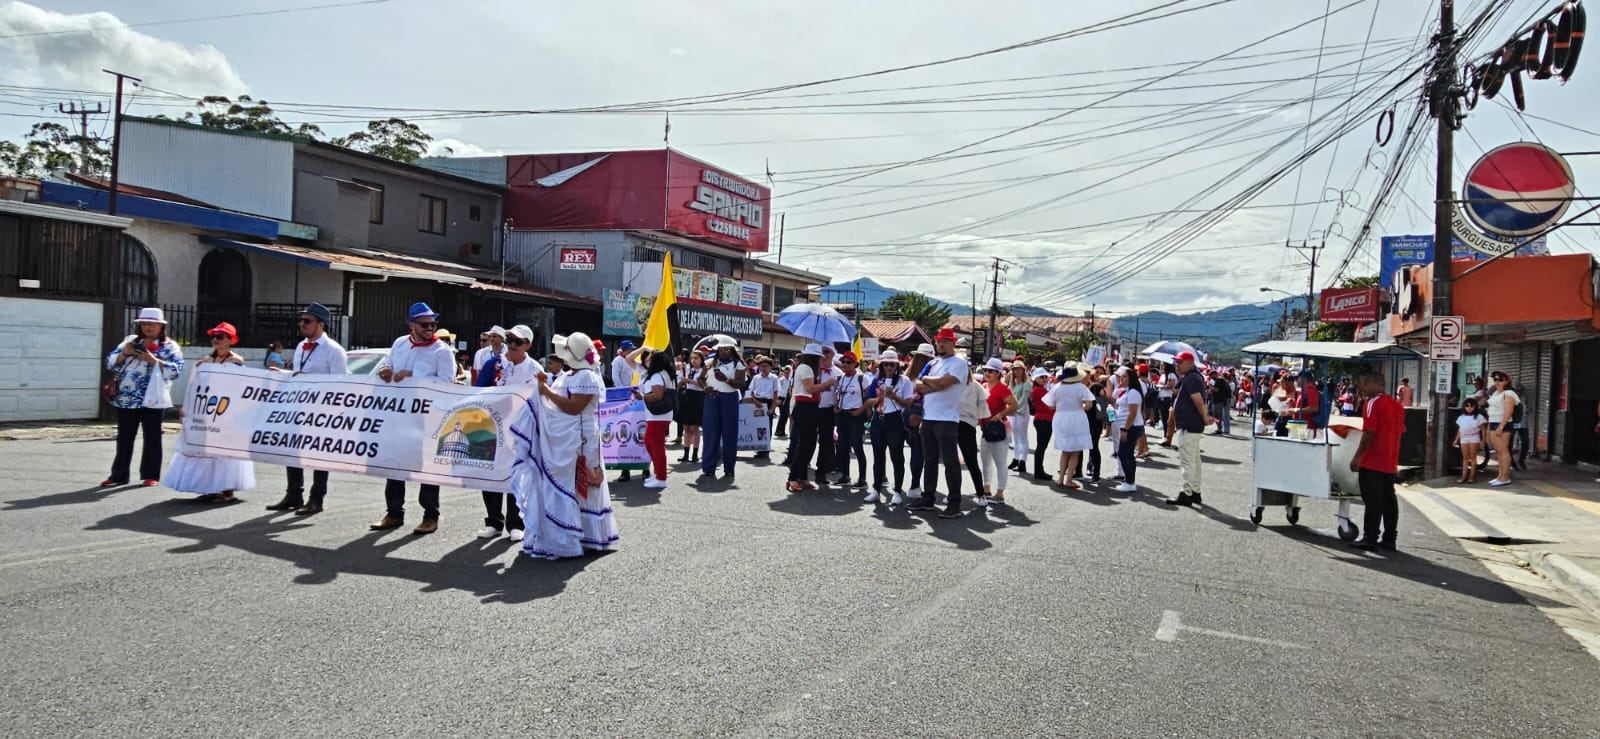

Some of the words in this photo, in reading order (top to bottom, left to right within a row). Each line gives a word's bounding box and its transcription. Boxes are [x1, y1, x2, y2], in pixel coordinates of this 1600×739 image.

[704, 170, 760, 200] DISTRIBUIDORA
[1452, 219, 1510, 254] BURGUESAS
[564, 253, 594, 263] REY
[680, 310, 687, 328] DE
[688, 310, 697, 329] LAS
[697, 312, 718, 331] PINTURAS
[722, 314, 732, 332] LOS
[732, 316, 749, 334] PRECIOS
[1440, 323, 1453, 337] E
[241, 385, 320, 404] DIRECCIÓN
[322, 391, 406, 413] REGIONAL
[410, 398, 433, 414] DE
[266, 410, 356, 431] EDUCACIÓN
[358, 418, 384, 434] DE
[251, 430, 379, 458] DESAMPARADOS
[433, 457, 495, 470] DESAMPARADOS
